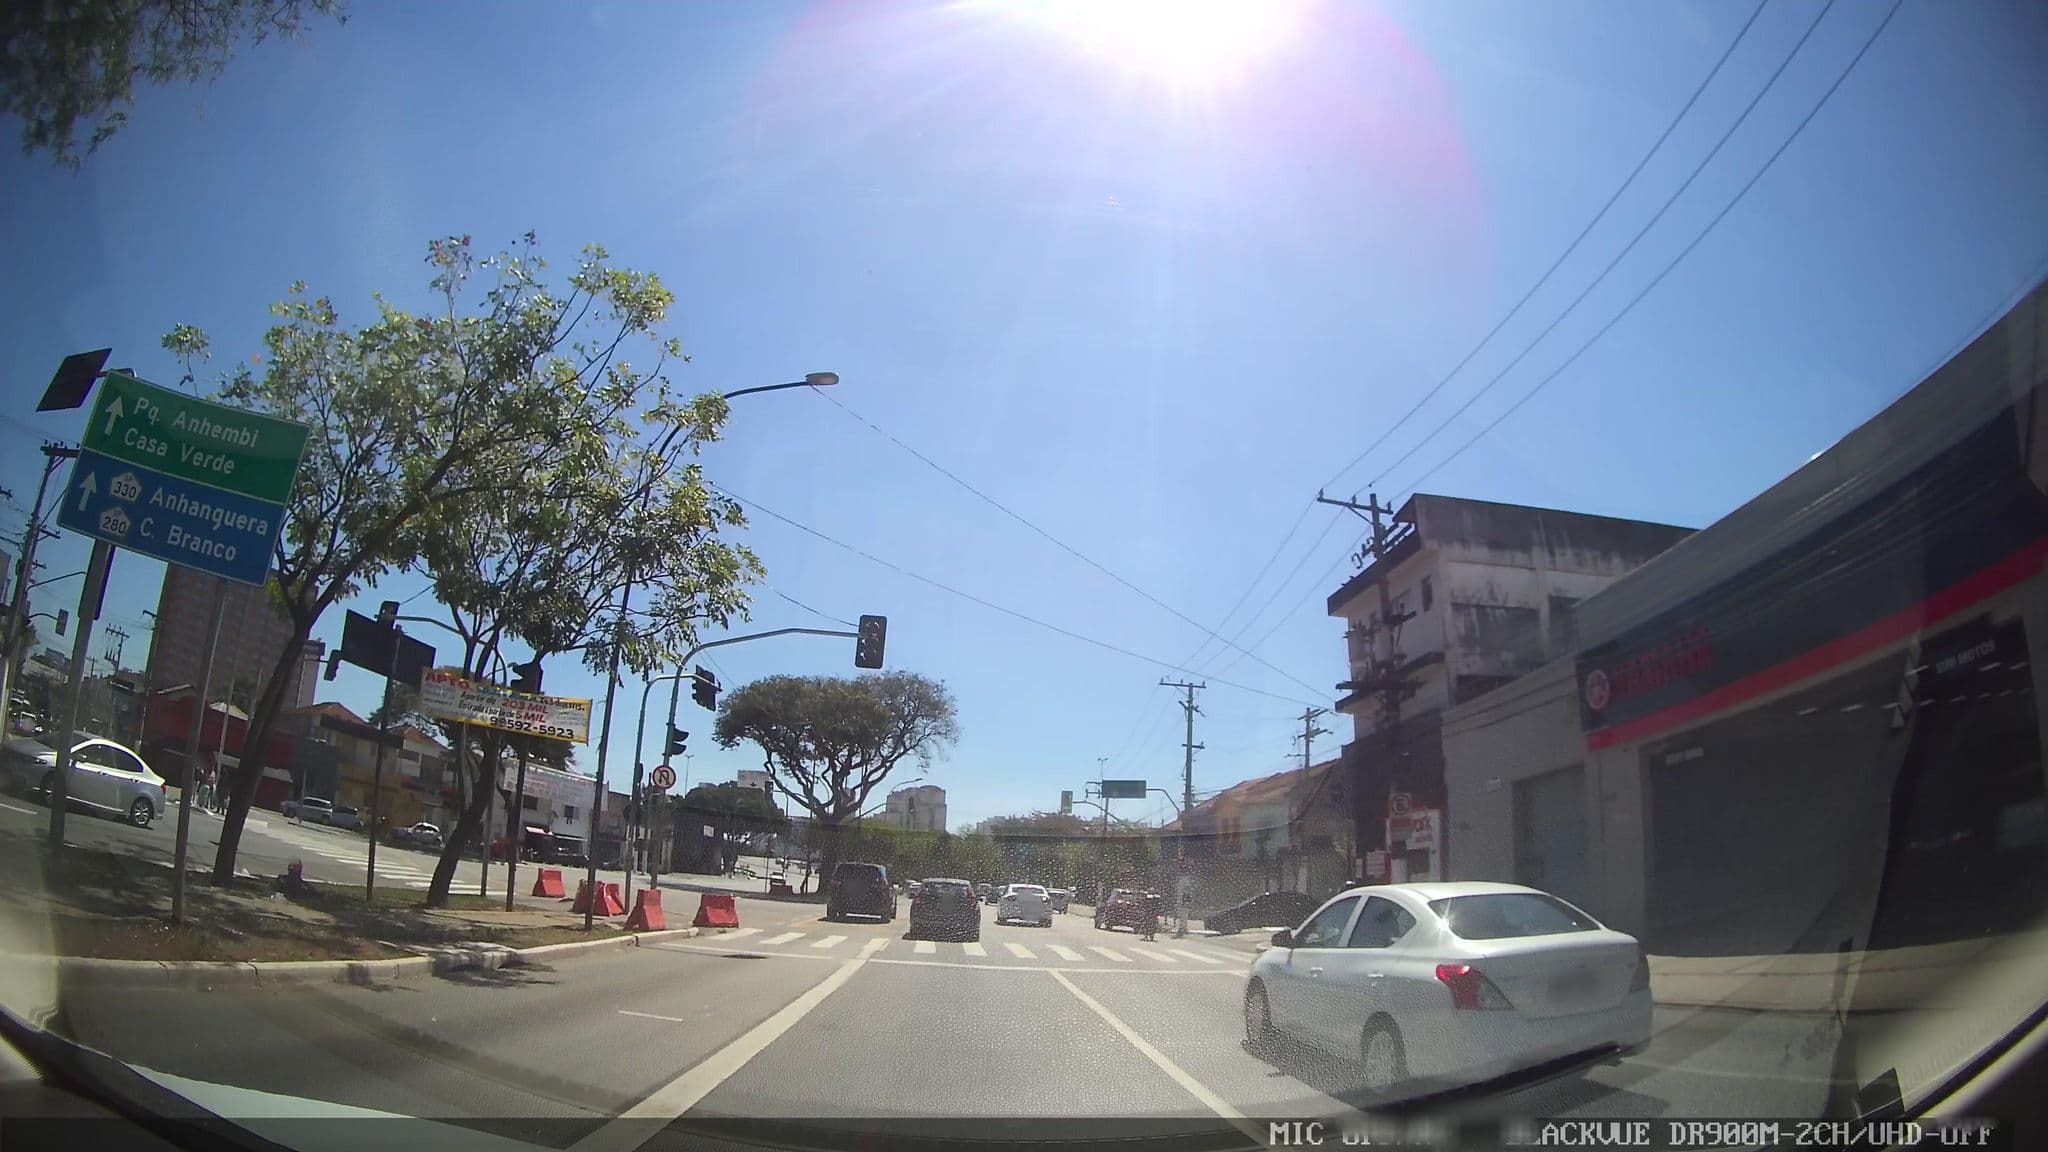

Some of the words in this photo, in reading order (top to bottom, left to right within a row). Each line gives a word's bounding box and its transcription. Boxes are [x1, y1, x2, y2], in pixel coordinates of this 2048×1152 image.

[134, 397, 160, 424] Pq.
[172, 410, 260, 448] Anhembi
[124, 428, 168, 456] Casa
[180, 443, 235, 474] Verde
[113, 481, 137, 500] 330
[149, 487, 268, 536] Anhanguera
[102, 516, 127, 534] 280
[139, 518, 155, 540] C.
[167, 525, 237, 561] Branco
[502, 698, 526, 710] 203
[528, 701, 549, 714] MIL
[523, 711, 547, 723] MIL
[490, 716, 574, 739] 99592-5923
